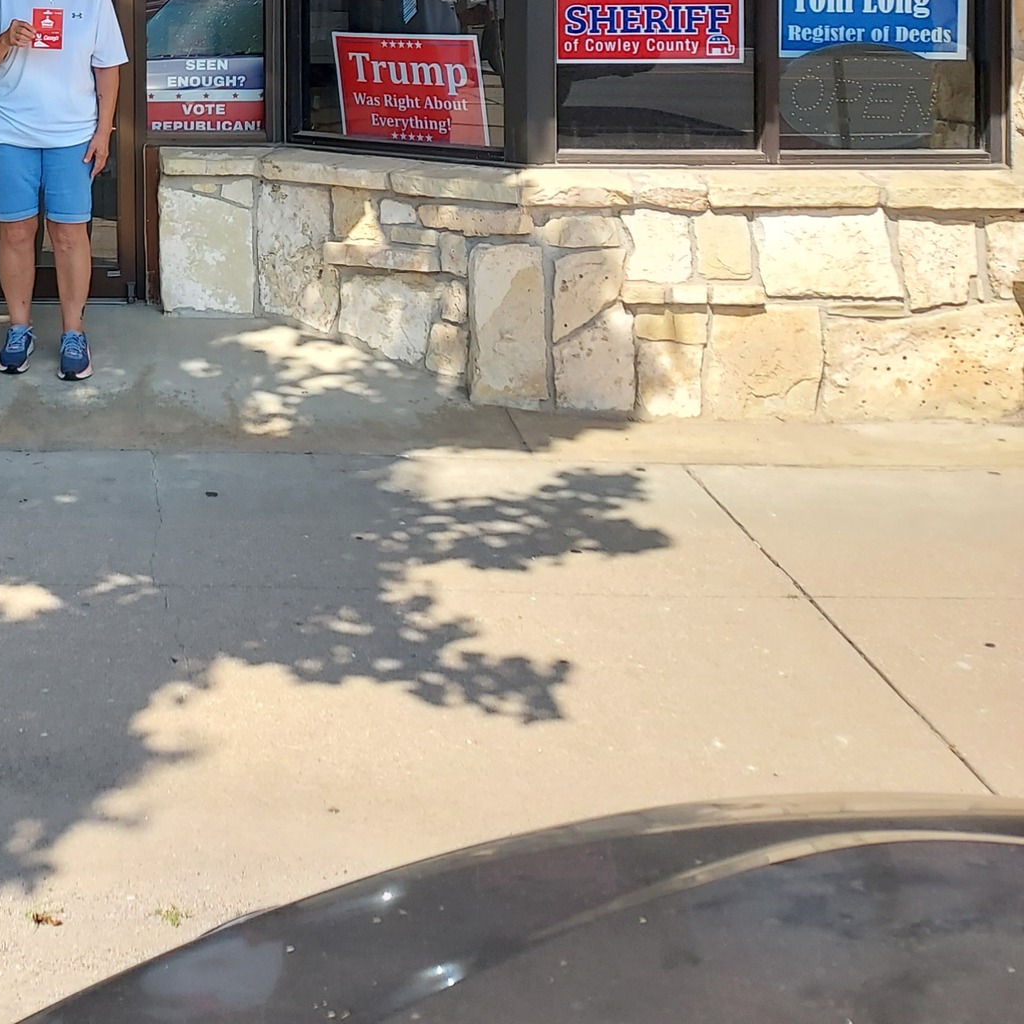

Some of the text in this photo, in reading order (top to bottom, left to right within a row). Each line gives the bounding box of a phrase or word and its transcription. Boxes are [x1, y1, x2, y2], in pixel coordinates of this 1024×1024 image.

[565, 4, 732, 36] SHERIFF
[787, 25, 952, 43] Register of Deeds
[564, 38, 699, 54] of Cowley County
[185, 59, 229, 71] SEEN
[348, 52, 468, 96] Trump
[167, 75, 246, 87] ENOUGH?
[352, 92, 468, 111] Was Right About
[791, 75, 938, 125] OPEN
[182, 103, 226, 116] VOTE
[151, 120, 261, 131] REPUBLICAN!
[371, 114, 452, 134] Everything!
